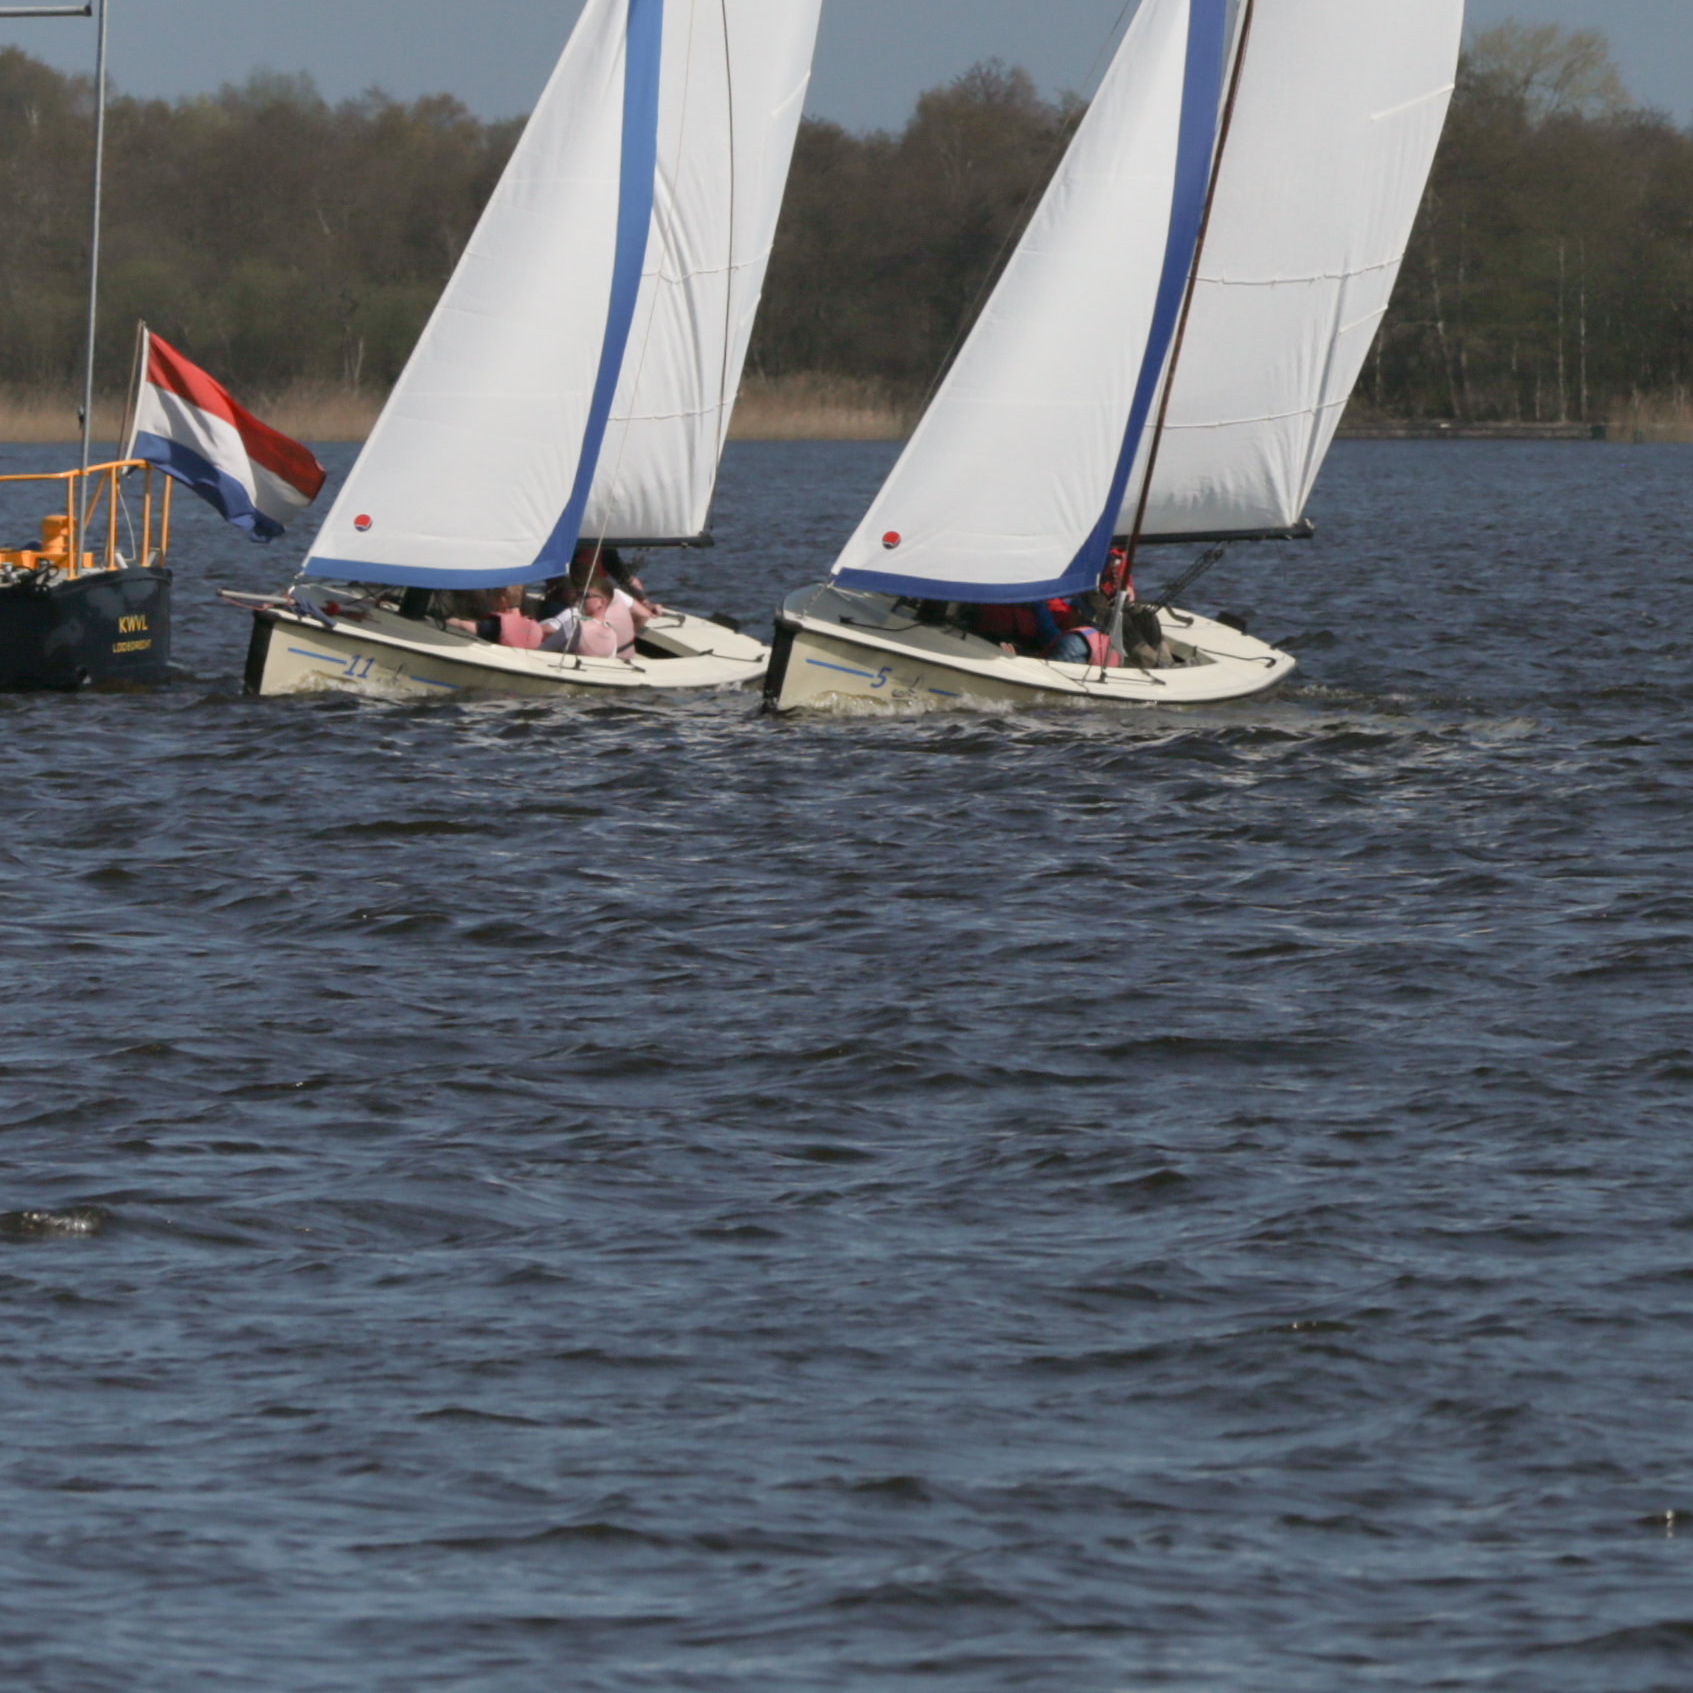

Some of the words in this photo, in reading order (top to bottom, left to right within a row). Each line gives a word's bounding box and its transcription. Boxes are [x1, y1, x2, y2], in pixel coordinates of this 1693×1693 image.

[119, 615, 148, 633] KWVL
[343, 654, 375, 678] 11
[870, 667, 892, 688] 5
